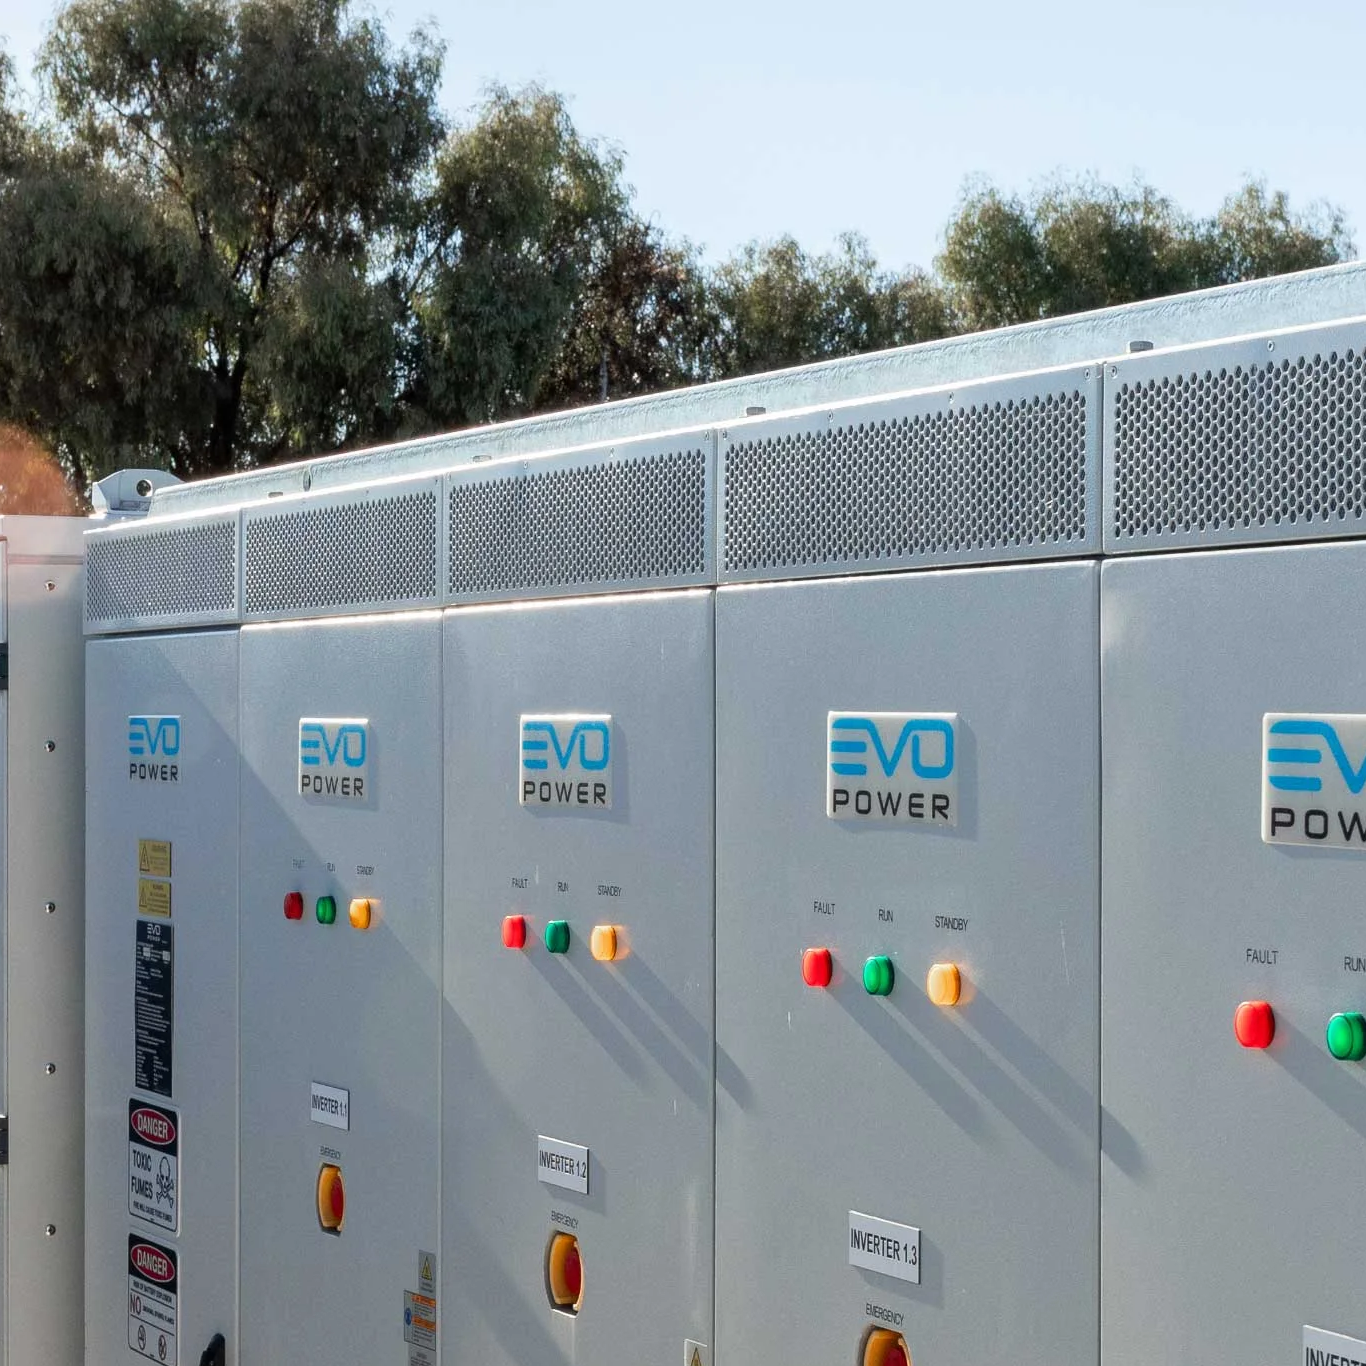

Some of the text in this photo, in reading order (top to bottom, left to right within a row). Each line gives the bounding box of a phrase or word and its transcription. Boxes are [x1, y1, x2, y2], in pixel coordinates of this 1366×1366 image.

[129, 717, 180, 756] EVO
[300, 723, 367, 768] EVO
[522, 720, 610, 771] EVO
[830, 718, 955, 779] EVO
[130, 763, 179, 782] POWER
[301, 774, 364, 797] POWER
[523, 780, 607, 804] POWER
[832, 788, 950, 820] POWER
[511, 878, 529, 889] FAULT
[557, 881, 569, 892] RUN
[597, 885, 622, 897] STANDBY
[813, 901, 836, 915] FAULT
[878, 908, 894, 922] RUN
[934, 915, 969, 931] STANDBY
[1246, 948, 1279, 965] FAULT
[1344, 956, 1366, 972] RUN
[312, 1094, 339, 1116] INVERTER
[137, 1113, 168, 1140] DANGER
[133, 1149, 151, 1172] TOXIC
[539, 1150, 587, 1178] INVERTER 1.2
[131, 1176, 153, 1200] FUMES
[850, 1227, 918, 1266] INVERTER 1.3
[137, 1248, 167, 1277] DANGER
[130, 1292, 141, 1315] NO
[866, 1302, 905, 1326] EMERGENCY
